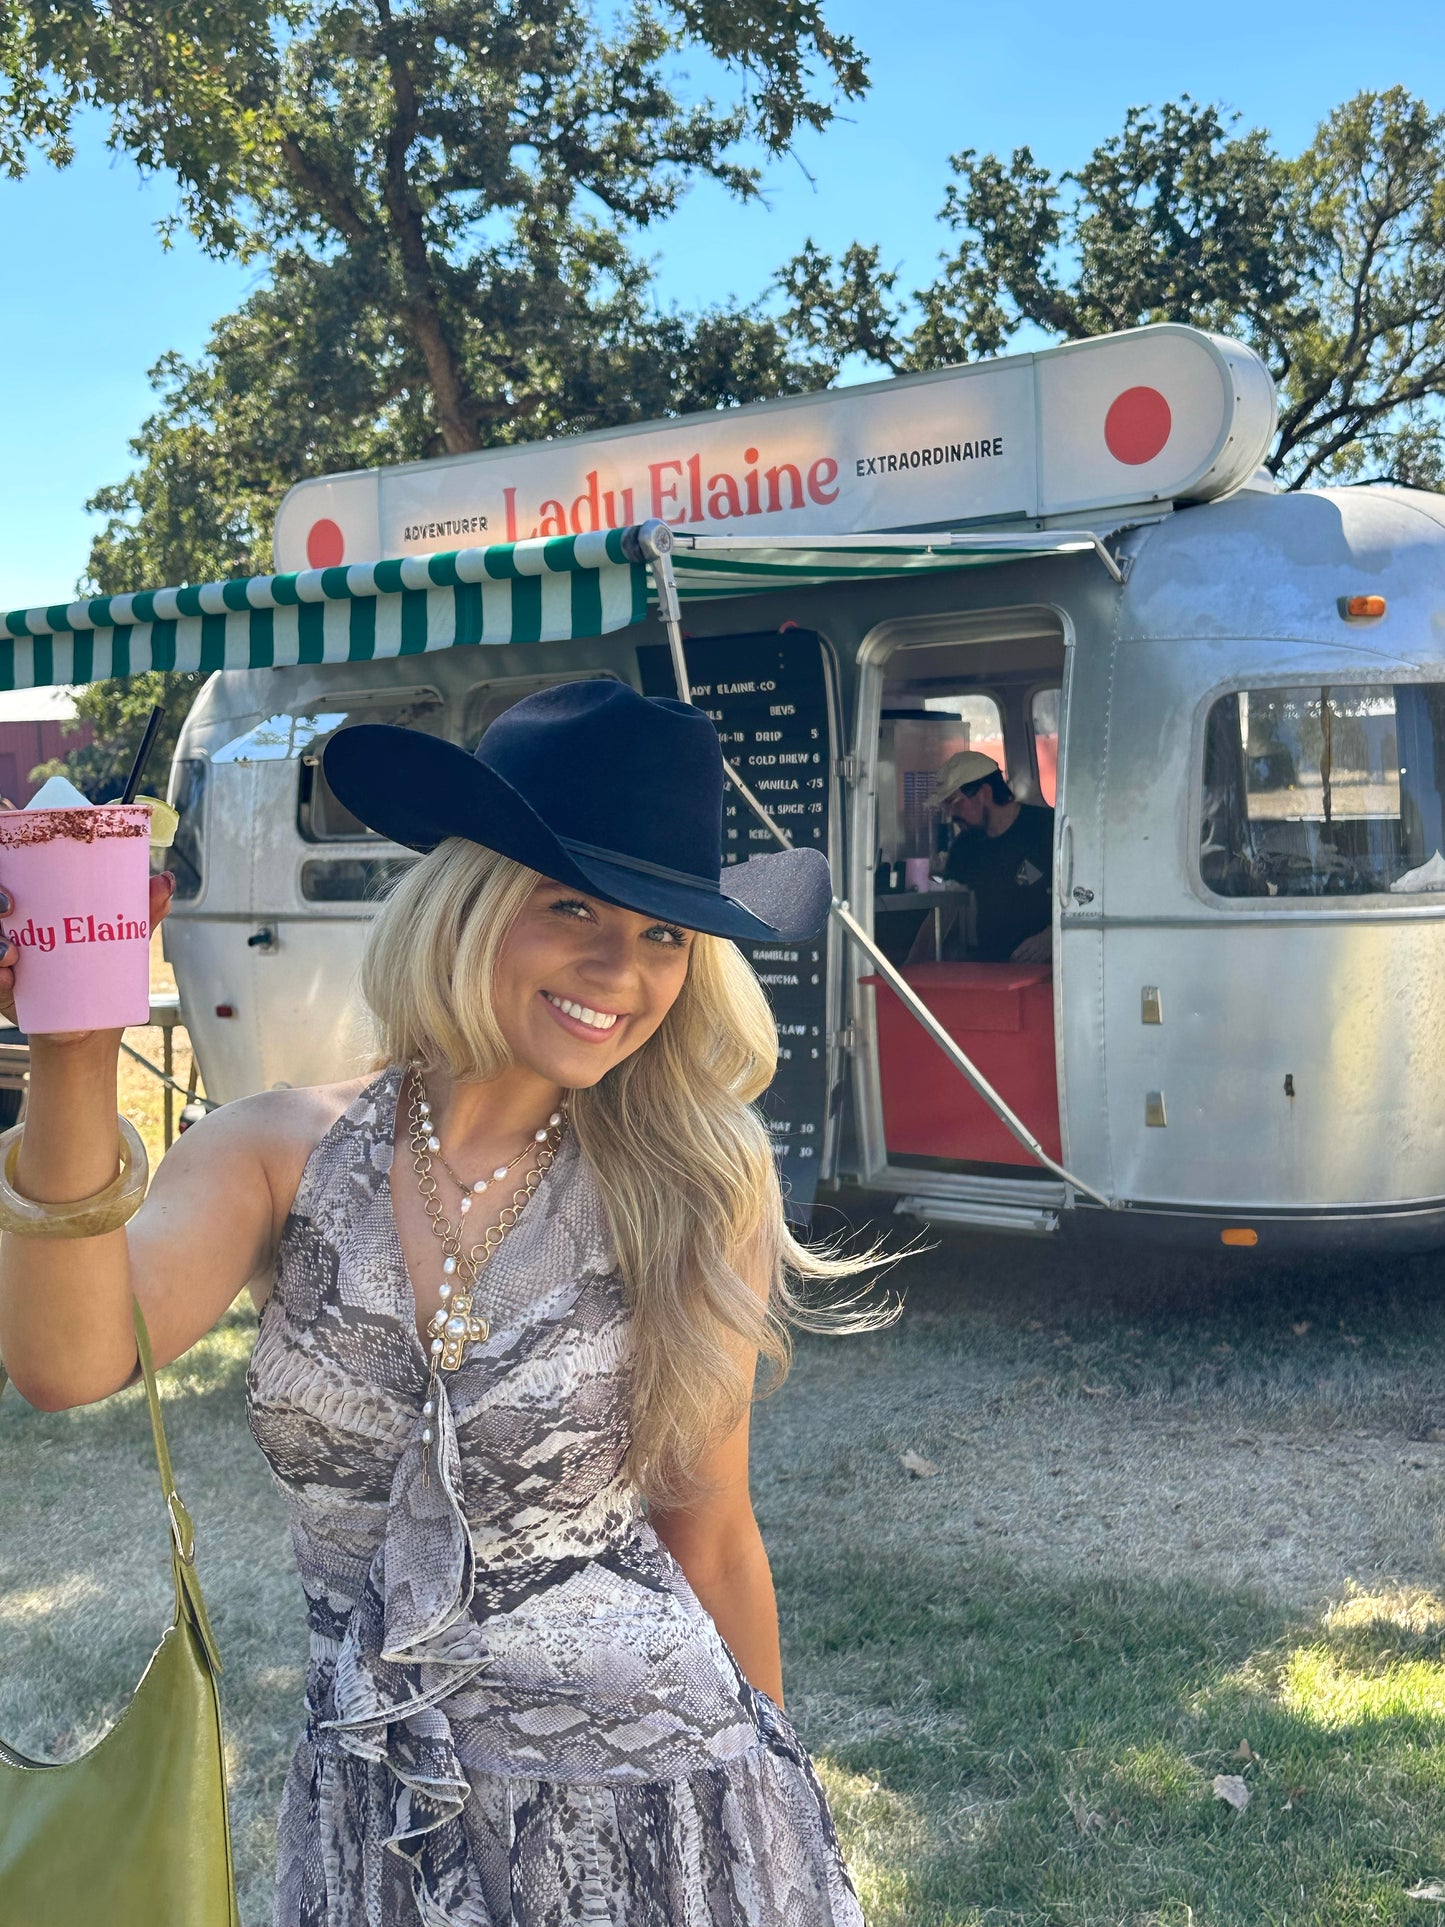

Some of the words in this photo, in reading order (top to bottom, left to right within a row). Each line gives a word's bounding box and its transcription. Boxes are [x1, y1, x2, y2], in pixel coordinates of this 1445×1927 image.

[856, 437, 1004, 477] EXTRAORDINAIRE
[648, 447, 840, 526] Elaine
[690, 685, 712, 697] ADY
[755, 731, 782, 742] DRIP
[748, 755, 776, 766] COLD
[779, 752, 809, 765] BREW
[9, 918, 56, 953] ady
[62, 913, 147, 945] Elaine
